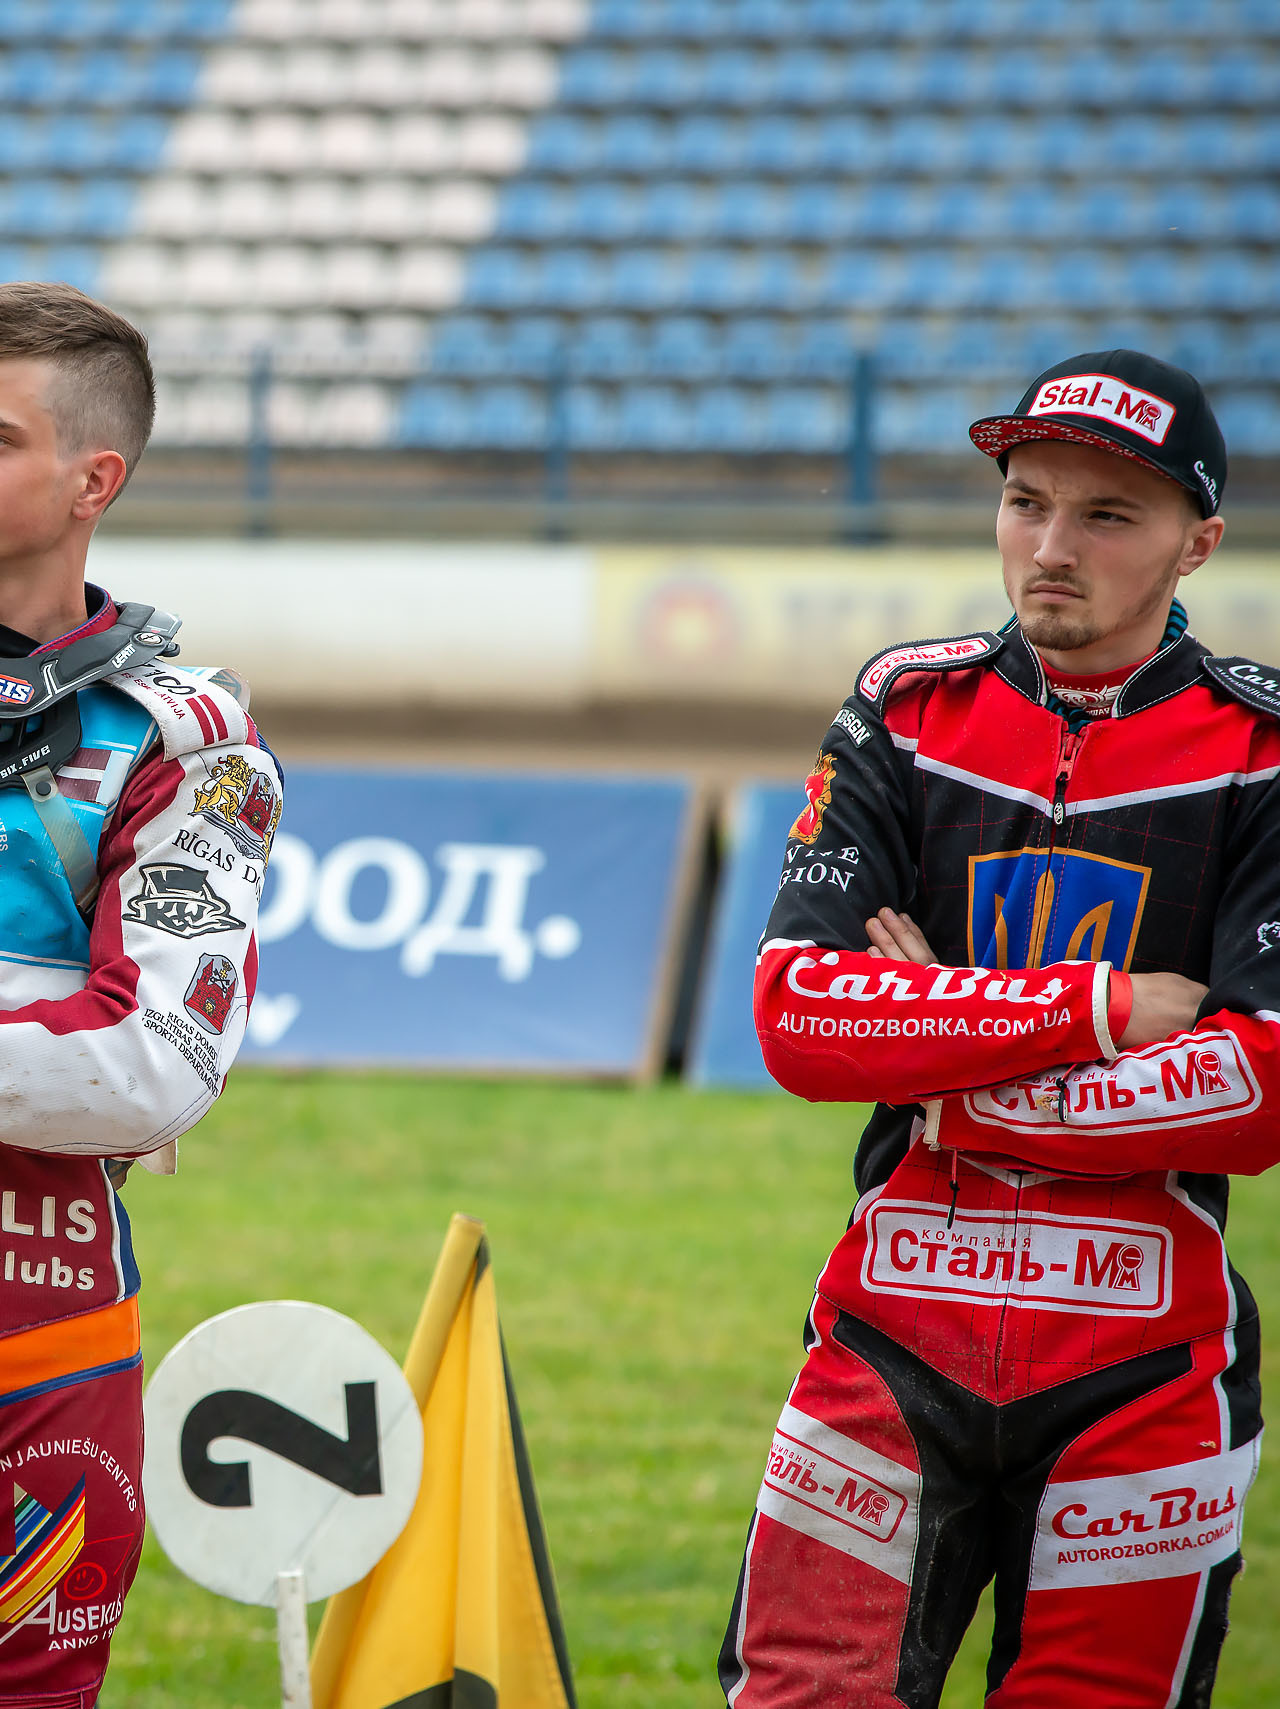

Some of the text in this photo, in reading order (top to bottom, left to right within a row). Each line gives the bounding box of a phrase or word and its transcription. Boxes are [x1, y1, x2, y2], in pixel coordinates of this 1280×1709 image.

[1227, 664, 1280, 697] Car
[172, 829, 235, 873] RĪGAS
[143, 1019, 178, 1048] SPORTA
[776, 1008, 1073, 1039] AUTOROZBORKA.COM.UA
[180, 1381, 384, 1509] 2
[15, 1436, 100, 1468] JAUNIEŠU
[99, 1449, 138, 1513] CENTRS
[1056, 1519, 1234, 1565] AUTOROZBORKA.COM.UA
[48, 1632, 99, 1652] ANNO
